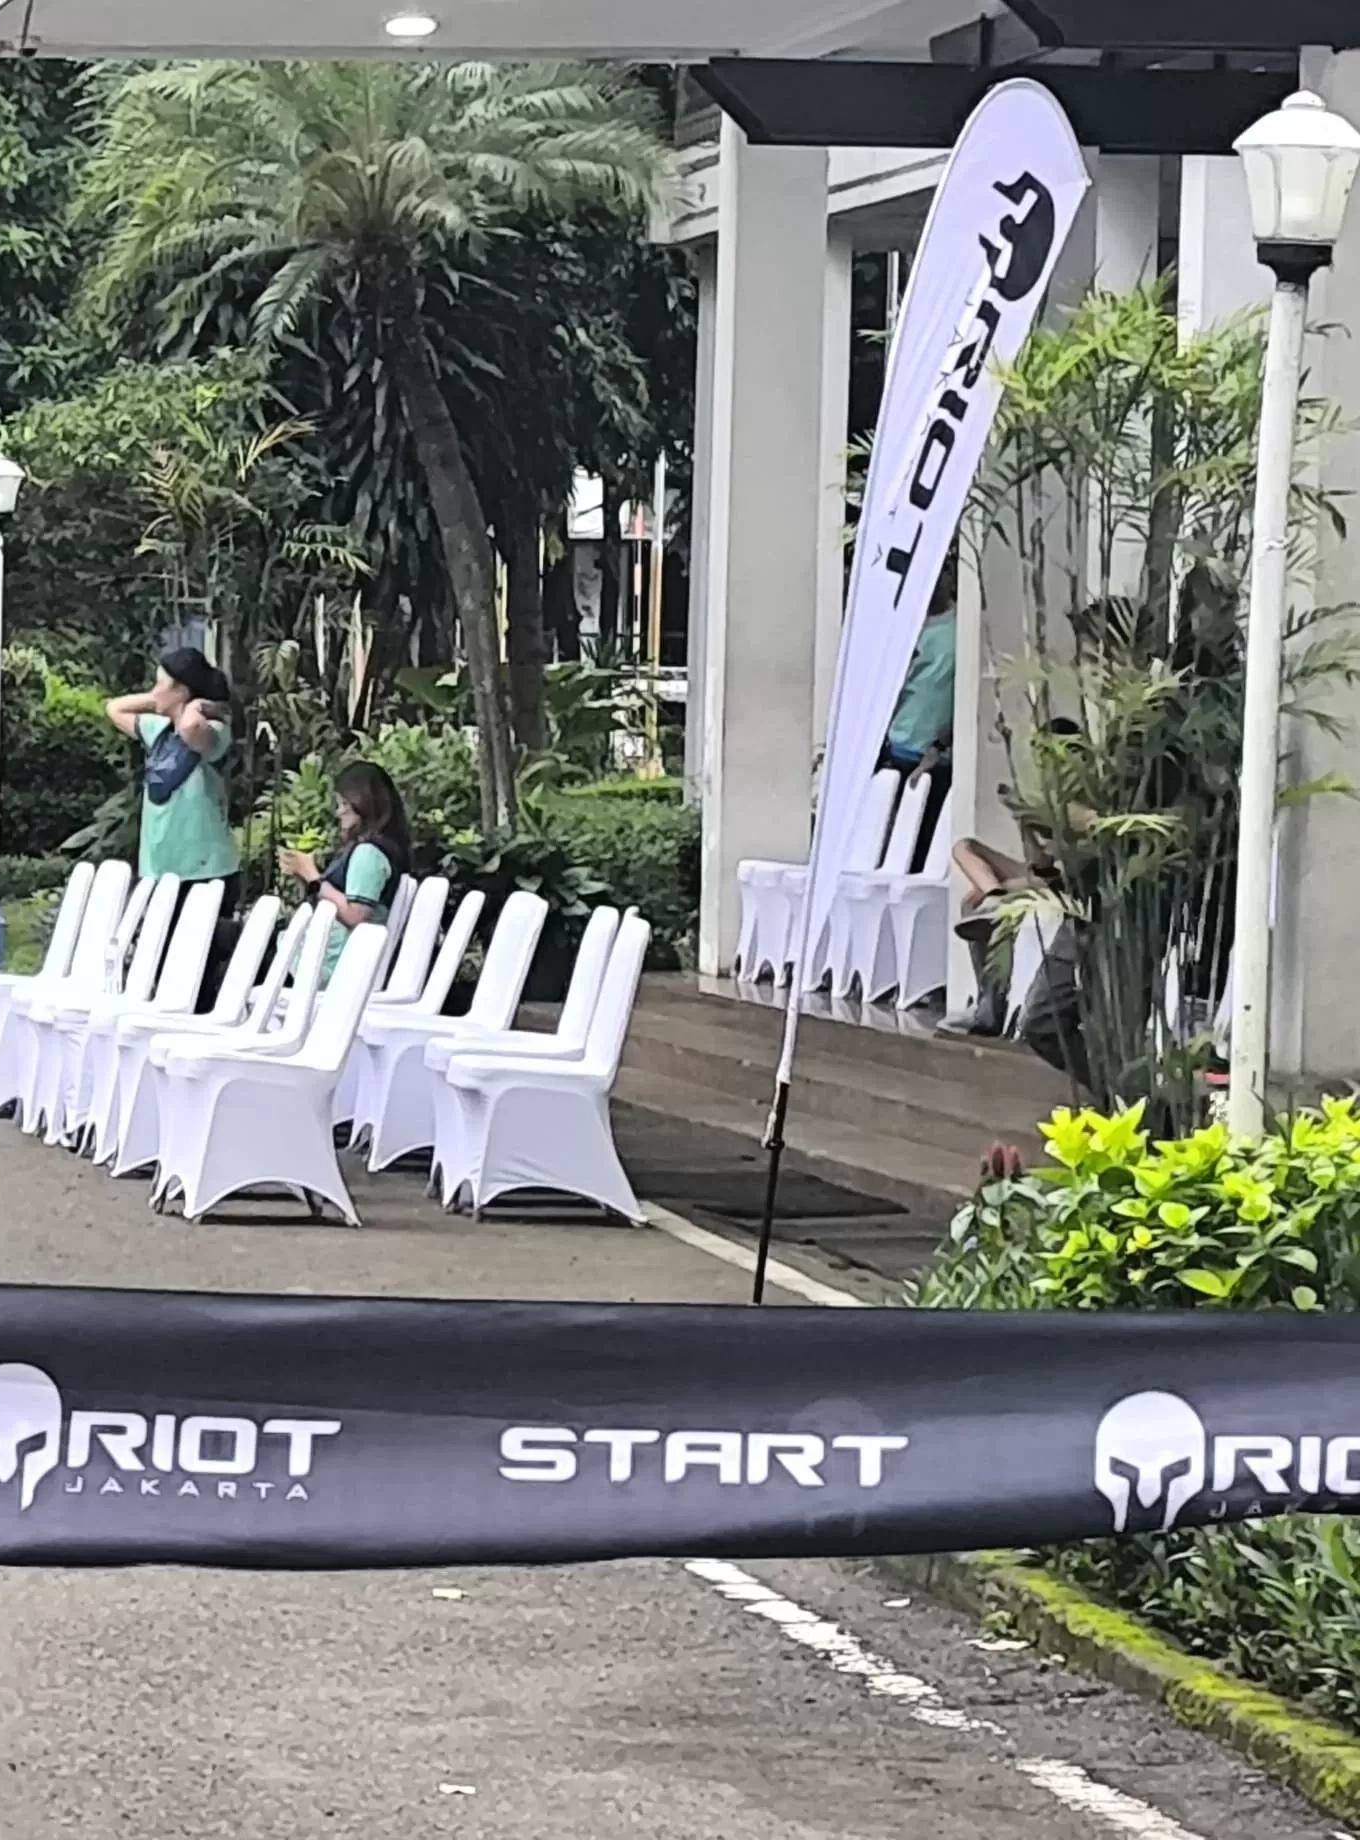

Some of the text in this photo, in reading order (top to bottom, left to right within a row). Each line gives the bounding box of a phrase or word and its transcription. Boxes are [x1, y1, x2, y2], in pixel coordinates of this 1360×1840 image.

[886, 299, 1001, 611] RIOT
[67, 1411, 342, 1476] RIOT
[499, 1427, 909, 1487] START
[65, 1476, 309, 1501] JAKARTA
